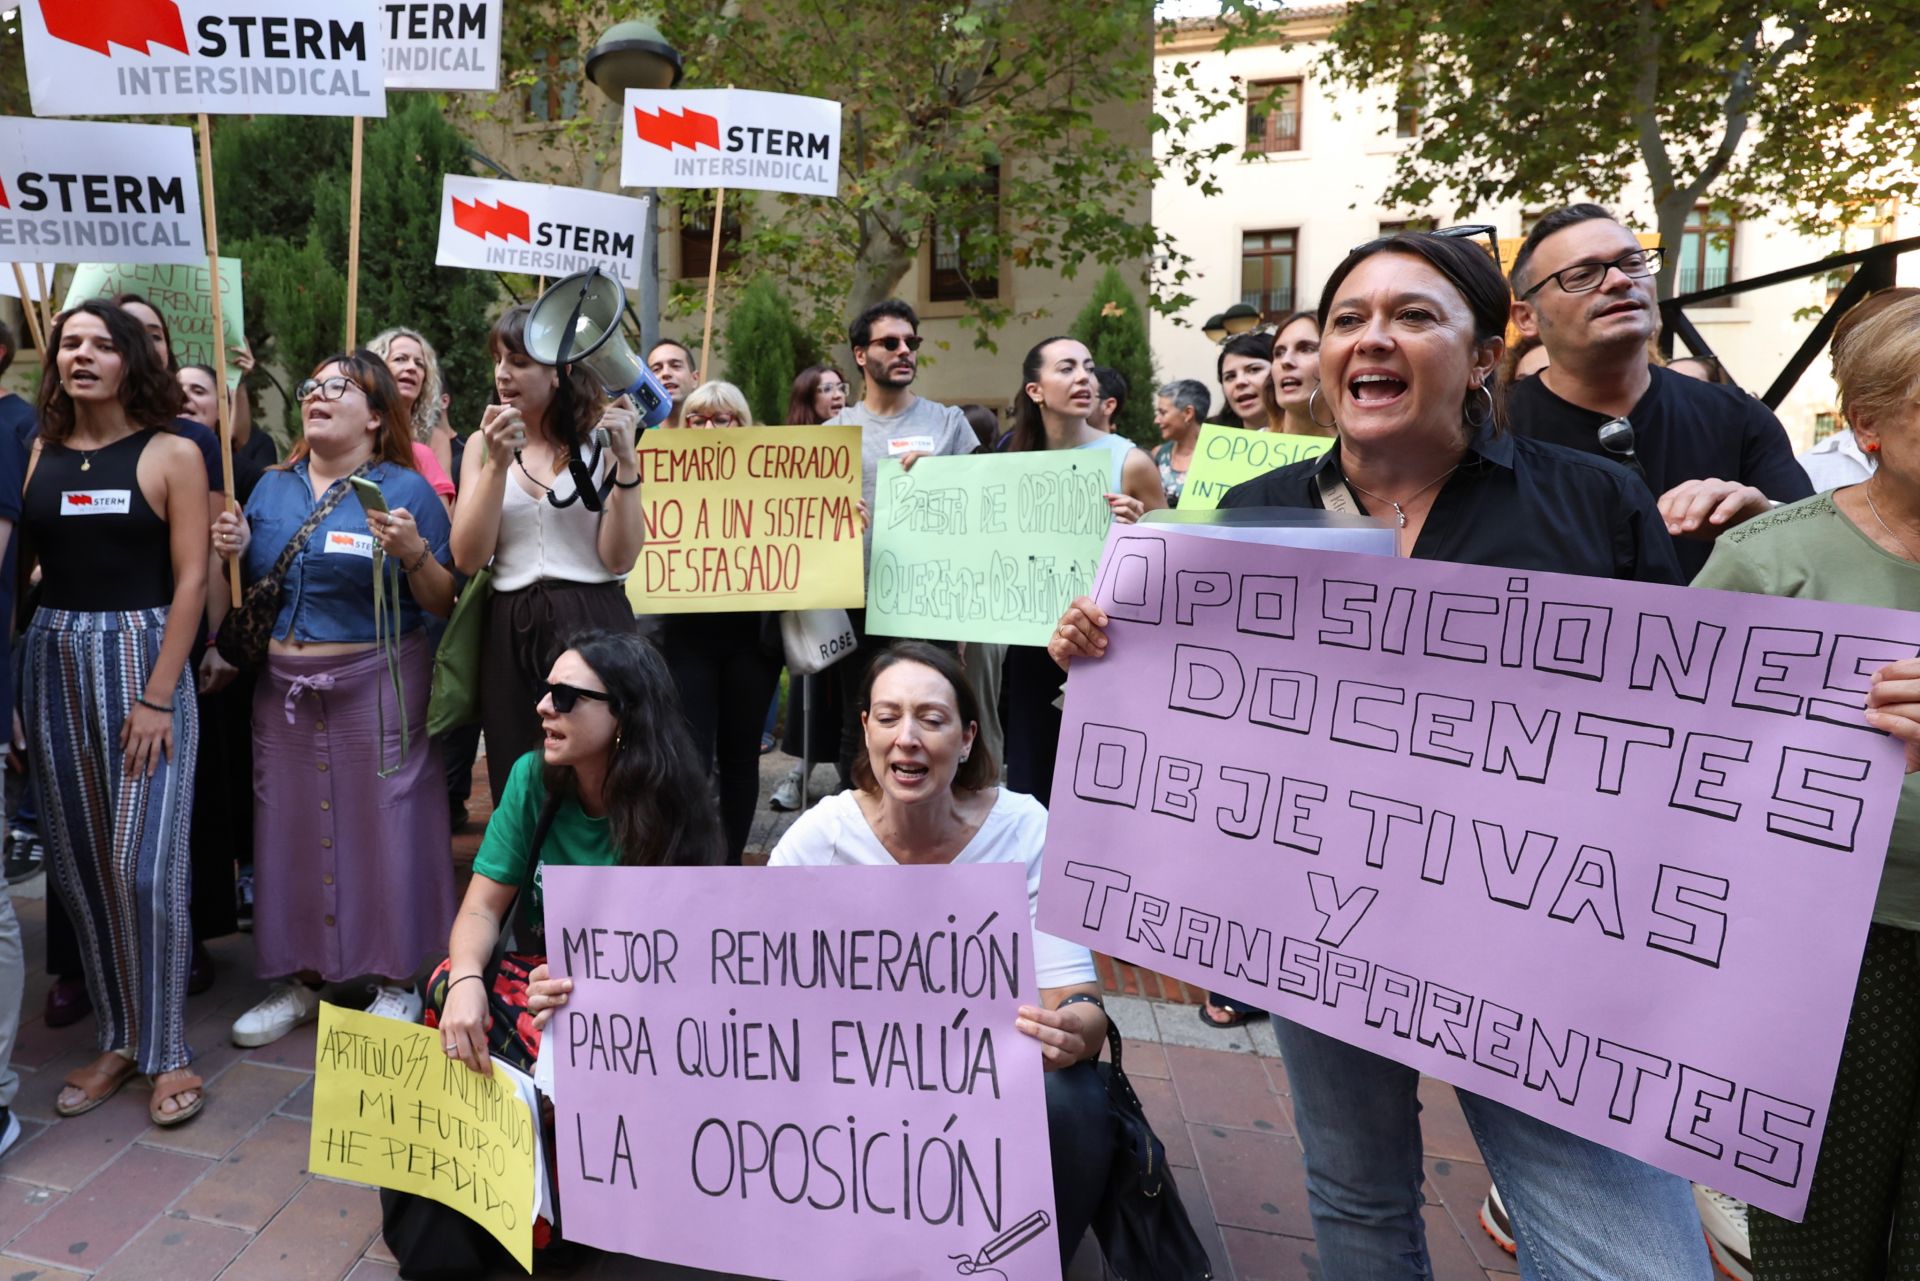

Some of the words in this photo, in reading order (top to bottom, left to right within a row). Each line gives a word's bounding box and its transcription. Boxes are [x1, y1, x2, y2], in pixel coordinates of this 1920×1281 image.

[197, 15, 366, 61] STERM
[379, 3, 487, 40] TERM
[117, 65, 371, 97] INTERSINDICAL
[674, 158, 829, 183] INTERSINDICAL
[726, 126, 830, 160] STERM
[17, 171, 186, 214] STERM
[536, 222, 635, 259] STERM
[637, 441, 736, 484] TEMARIO
[747, 445, 854, 484] CERRADO,
[643, 499, 683, 539] NO
[695, 498, 709, 539] A
[722, 498, 753, 539] UN
[764, 496, 855, 541] SISTEMA
[888, 474, 969, 535] BASTA
[980, 483, 1008, 533] DE
[645, 543, 801, 593] DESFASADO
[820, 632, 852, 660] ROSE
[1094, 536, 1920, 737] OPOSICIONES
[1168, 644, 1872, 851] DOCENTES
[1073, 722, 1729, 968] OBJETIVAS
[1307, 870, 1379, 948] Y
[563, 927, 678, 984] MEJOR
[712, 910, 1019, 1001] REMUNERACIÓN
[1064, 859, 1815, 1188] TRANSPARENTES
[568, 1012, 657, 1077] PARA
[676, 1008, 801, 1083] QUIEN
[832, 1007, 1001, 1100] EVALÚA
[358, 1088, 396, 1125] MI
[407, 1099, 505, 1177] FUTURO
[320, 1127, 373, 1168] HE
[380, 1136, 517, 1231] PERDIDO
[576, 1113, 638, 1191] LA
[690, 1113, 1003, 1233] OPOSICIÓN
